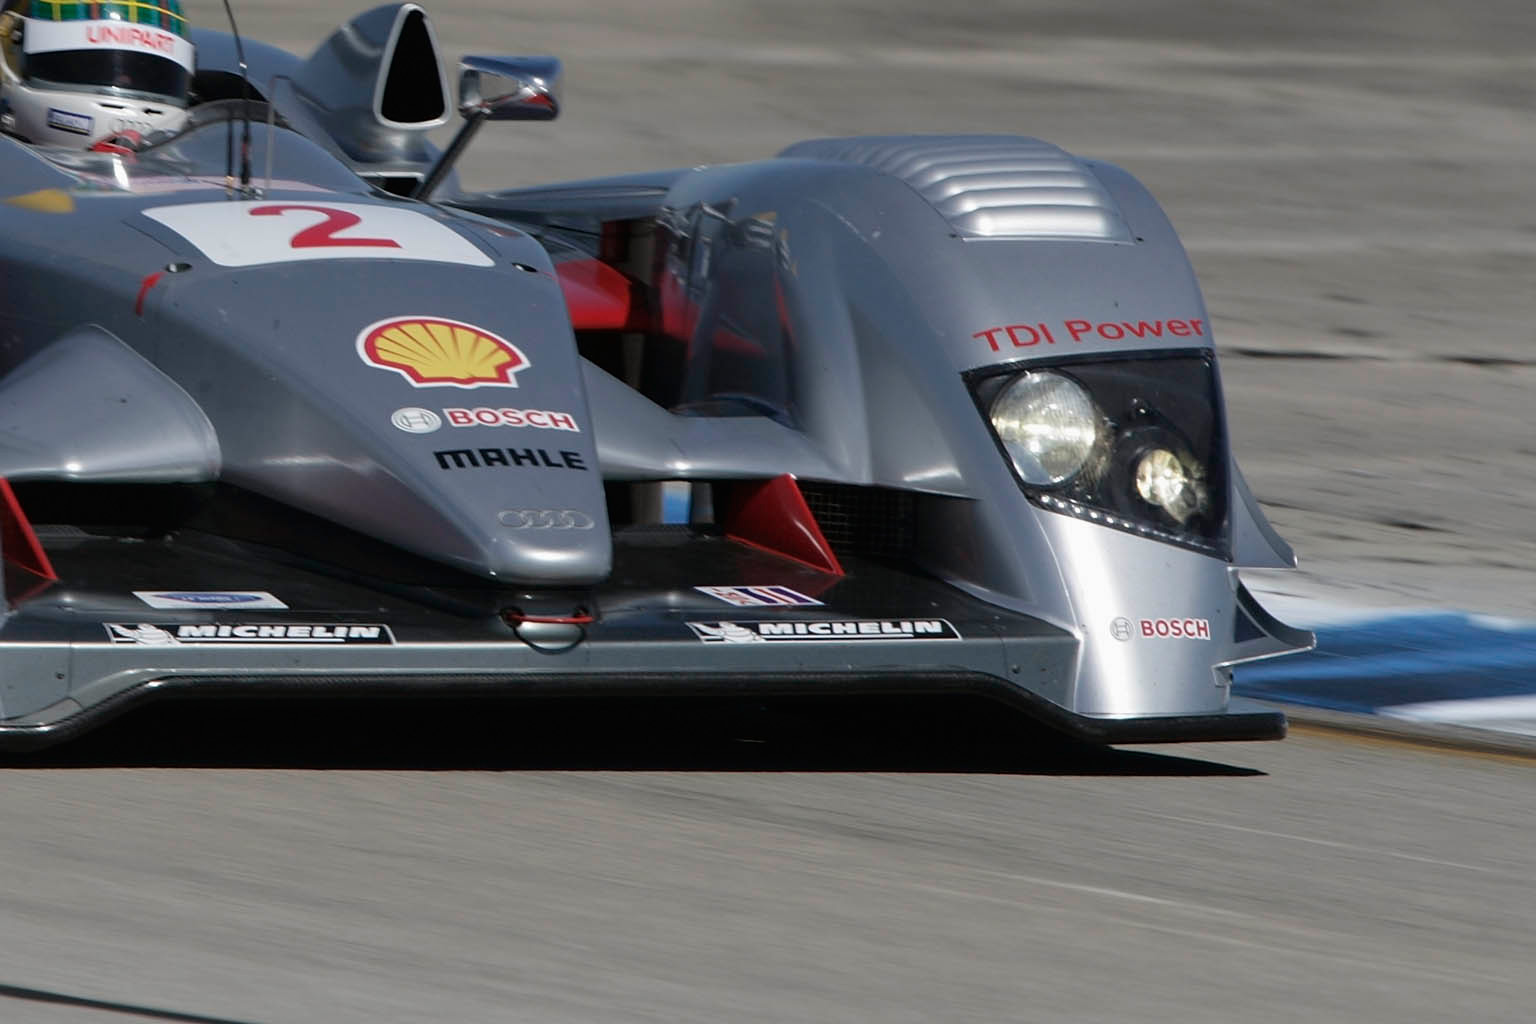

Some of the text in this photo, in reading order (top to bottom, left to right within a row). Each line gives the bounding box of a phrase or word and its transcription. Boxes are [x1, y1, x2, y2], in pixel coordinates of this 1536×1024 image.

[249, 205, 402, 248] 2
[972, 319, 1204, 353] TDI Power
[447, 408, 577, 430] BOSCH
[433, 448, 589, 471] MAHLE
[176, 624, 382, 639] MICHELIN
[758, 620, 943, 635] MICHELIN
[1139, 619, 1210, 639] BOSCH
